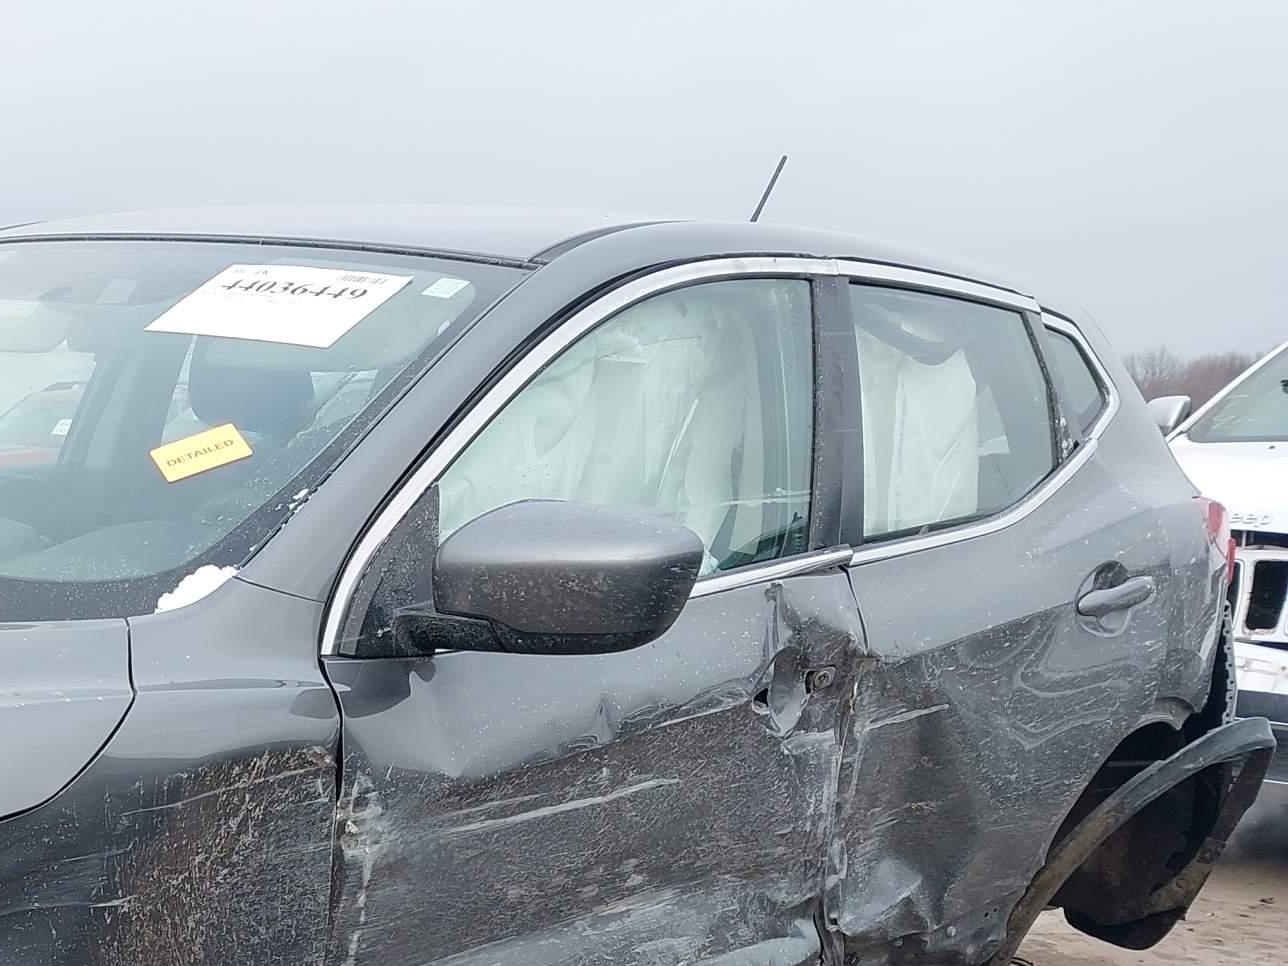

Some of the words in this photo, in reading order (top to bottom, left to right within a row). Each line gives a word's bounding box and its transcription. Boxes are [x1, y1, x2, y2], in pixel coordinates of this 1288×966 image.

[221, 279, 368, 300] 44036449
[166, 439, 234, 467] DETAILED
[1229, 512, 1273, 528] eep
